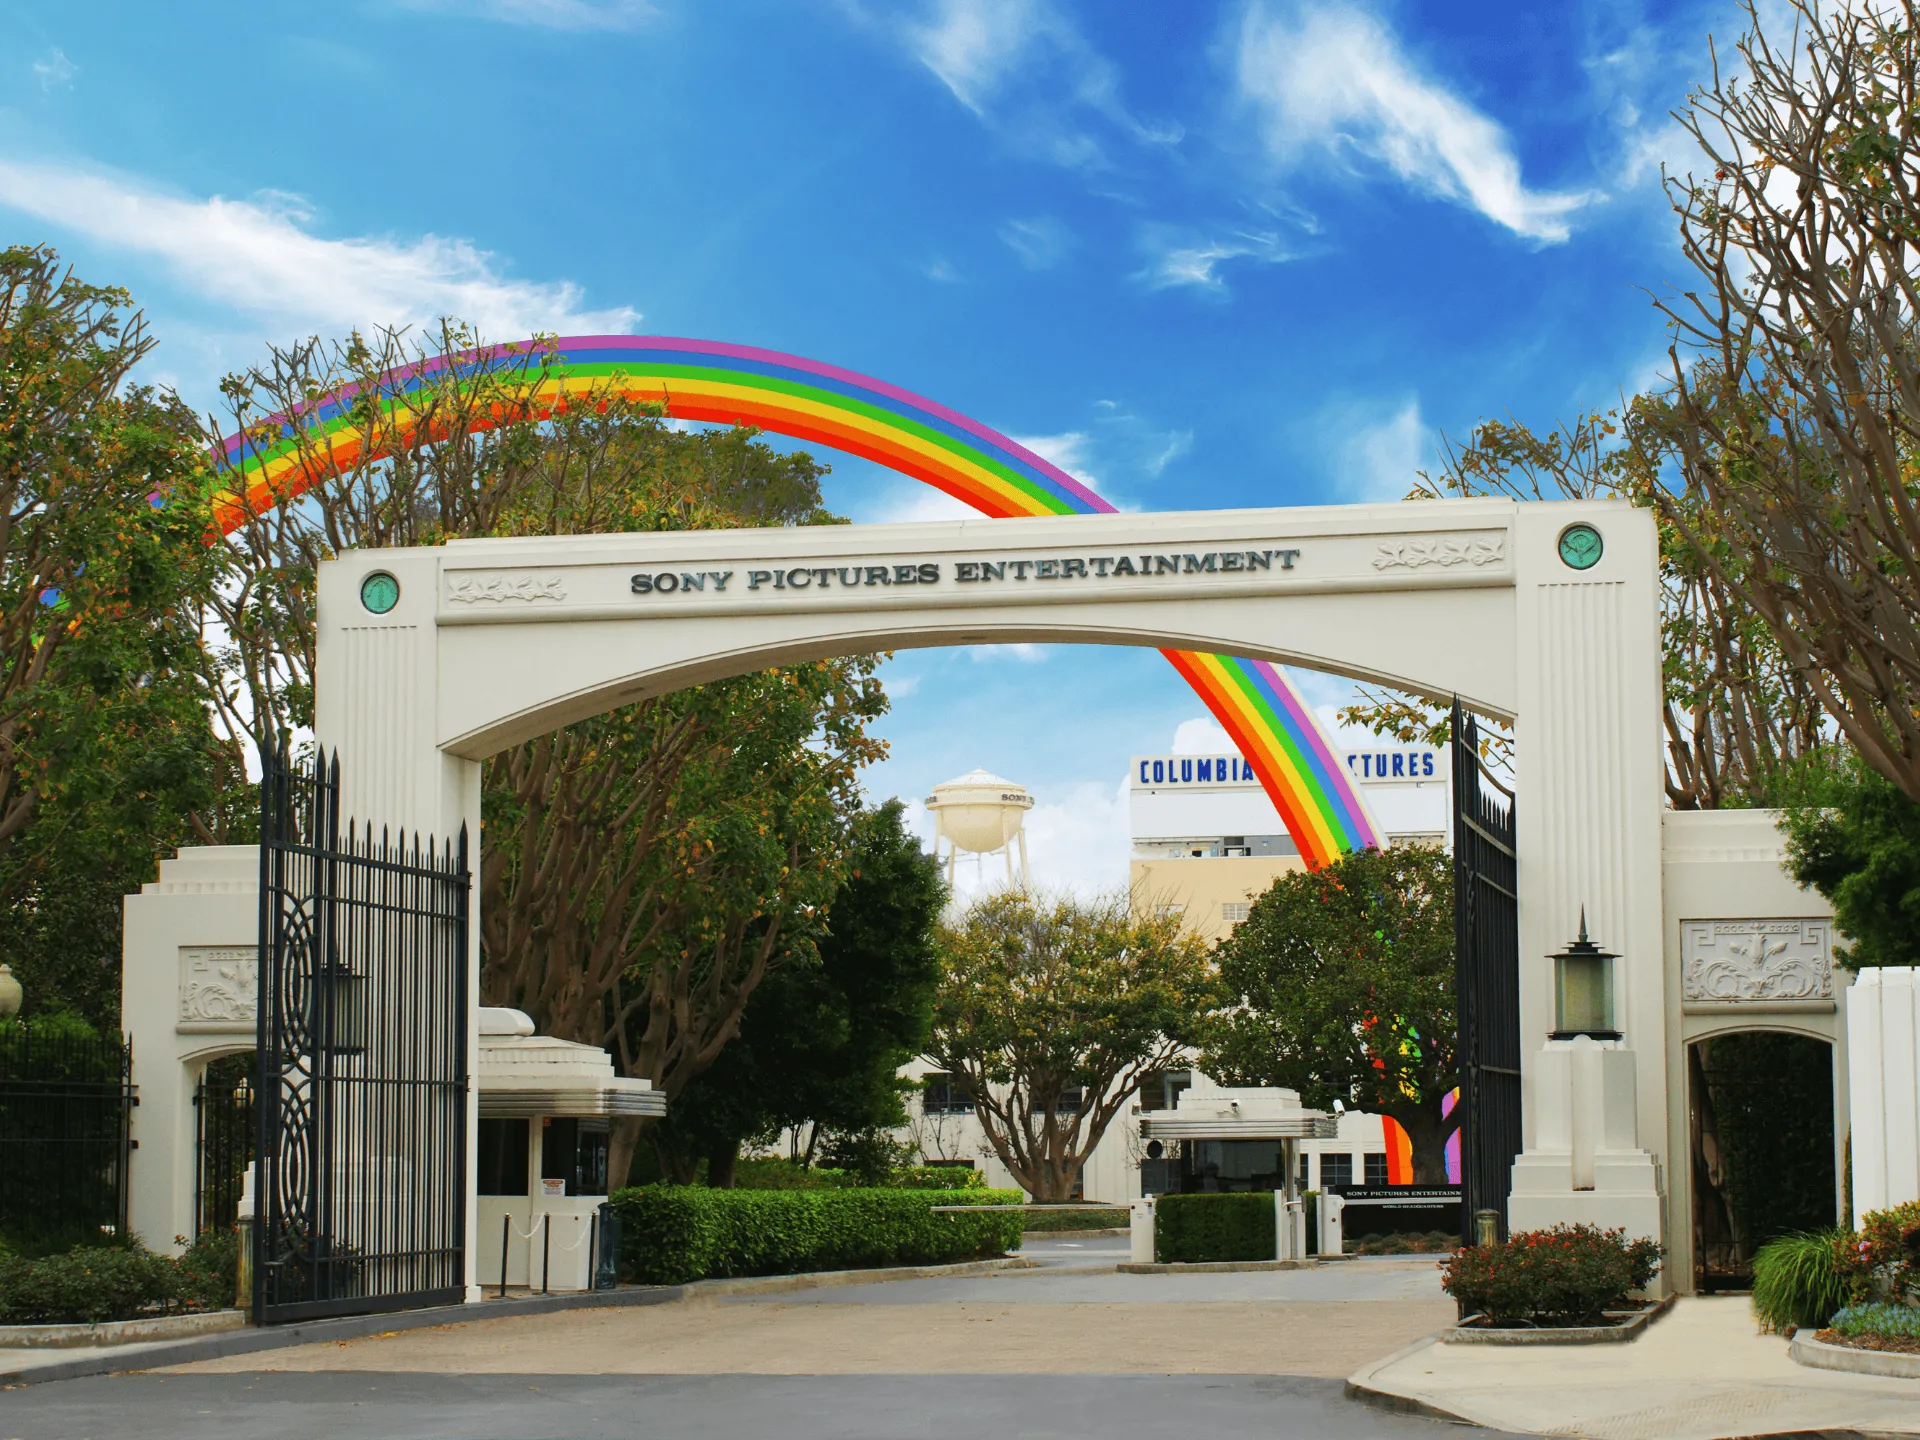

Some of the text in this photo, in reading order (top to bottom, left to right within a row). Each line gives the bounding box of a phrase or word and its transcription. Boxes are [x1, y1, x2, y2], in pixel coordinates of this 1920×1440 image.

[631, 549, 1300, 593] SONY PICTURES ENTERTAINMENT
[1140, 757, 1254, 783] COLUMBIA
